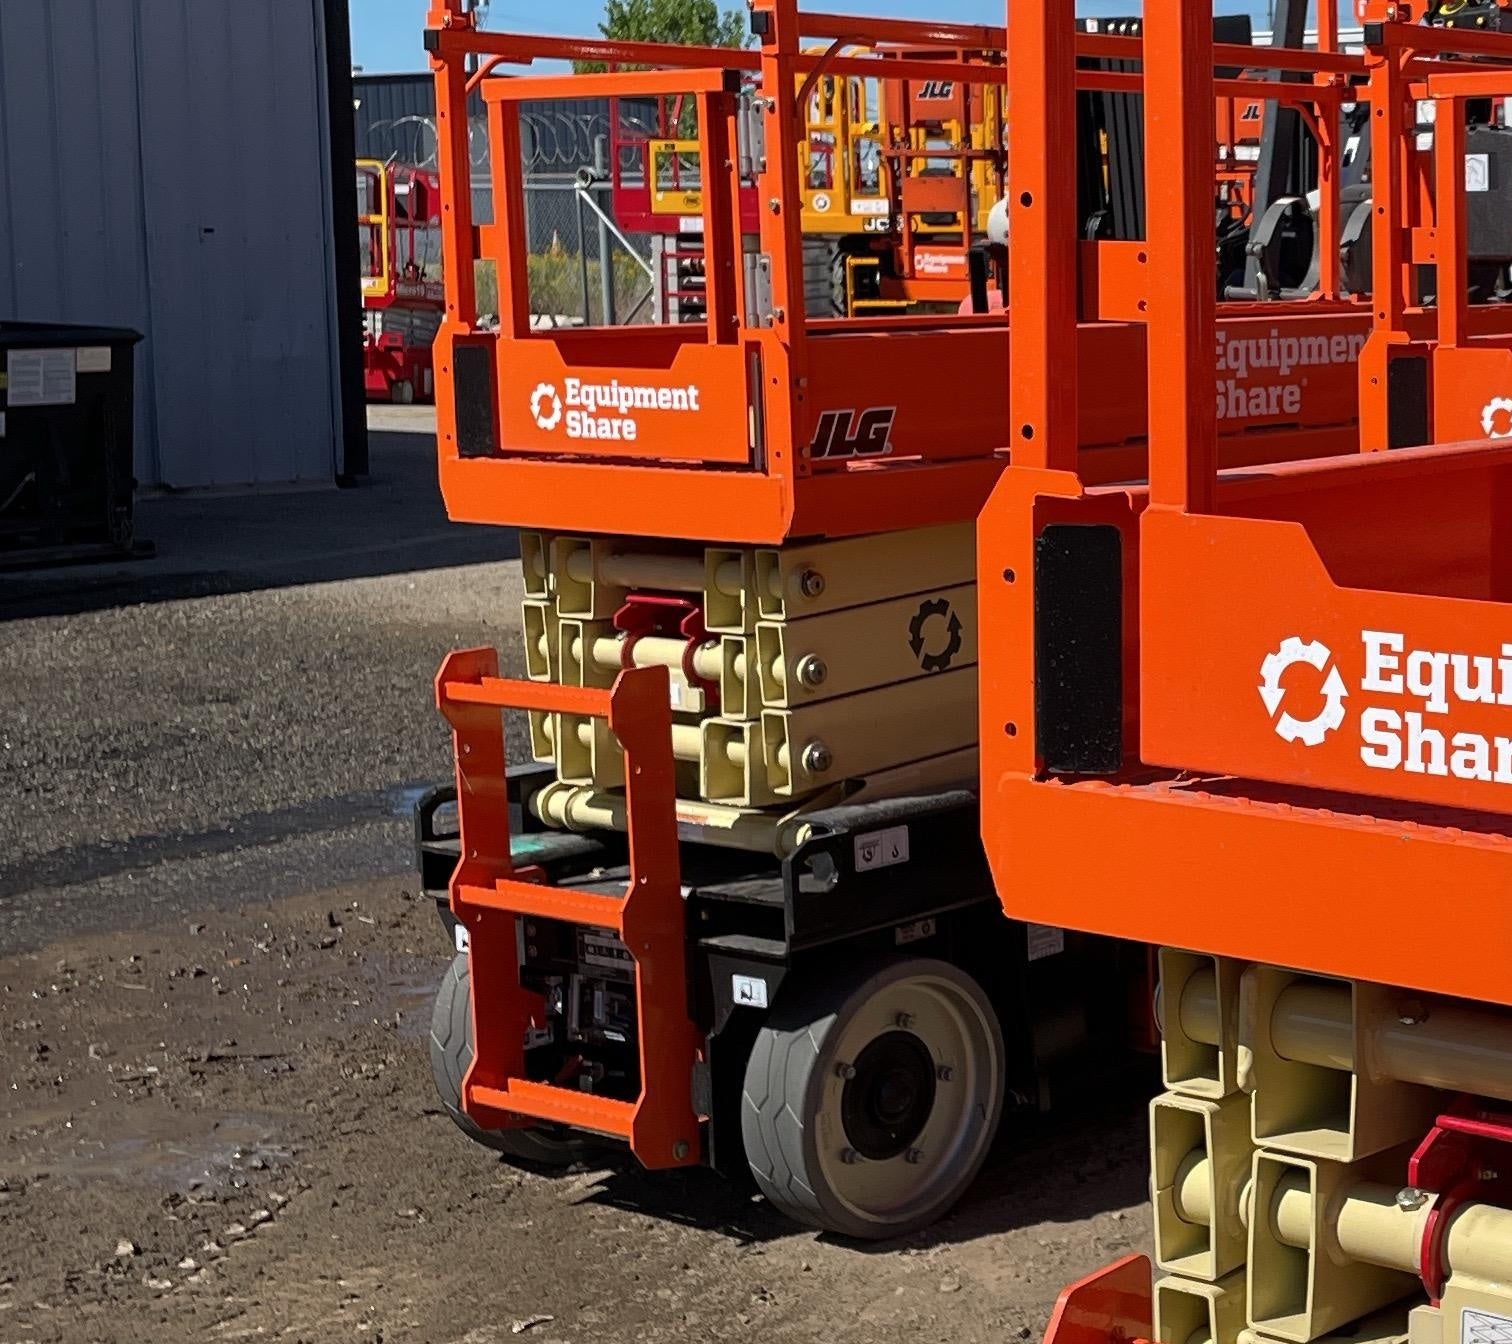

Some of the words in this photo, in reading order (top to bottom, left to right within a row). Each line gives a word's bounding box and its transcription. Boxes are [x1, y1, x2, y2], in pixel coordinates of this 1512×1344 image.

[917, 80, 954, 101] JLG
[1241, 104, 1261, 121] JL
[1215, 328, 1371, 379] Equipmen
[564, 377, 700, 412] Equipment
[565, 411, 638, 441] Share
[810, 405, 897, 462] JLG
